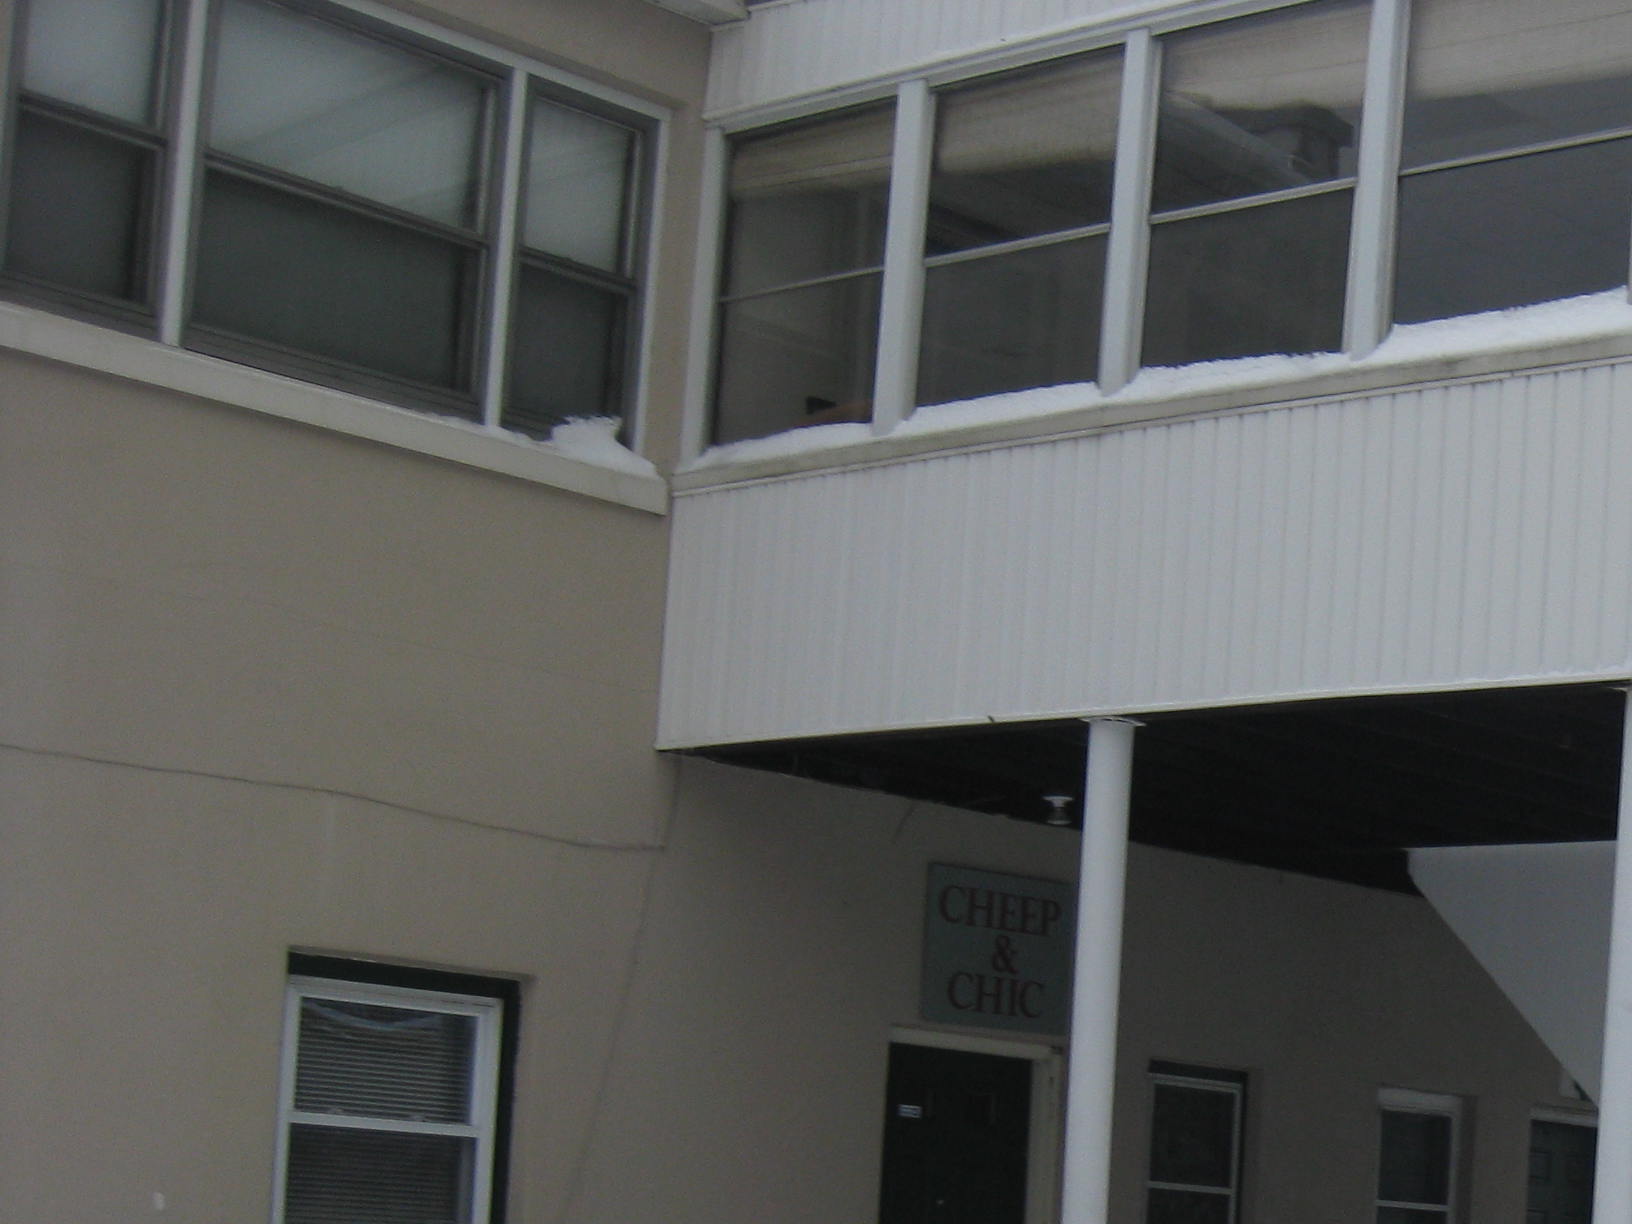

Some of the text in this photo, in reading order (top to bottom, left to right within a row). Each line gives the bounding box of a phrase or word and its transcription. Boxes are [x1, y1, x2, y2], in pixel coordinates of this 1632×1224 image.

[939, 885, 1063, 936] CHEEP
[992, 934, 1019, 974] &
[947, 971, 1045, 1019] CHIC
